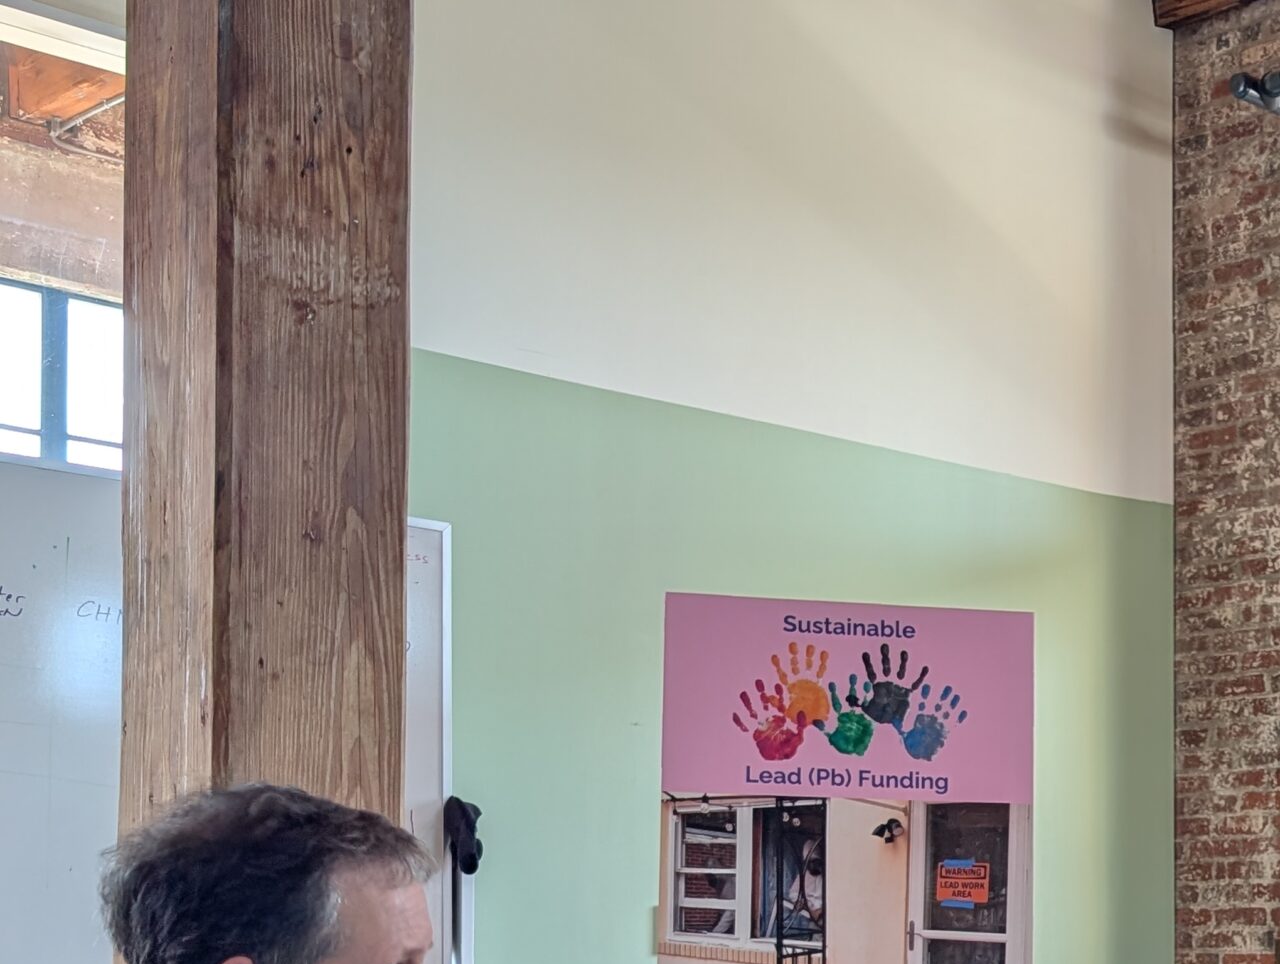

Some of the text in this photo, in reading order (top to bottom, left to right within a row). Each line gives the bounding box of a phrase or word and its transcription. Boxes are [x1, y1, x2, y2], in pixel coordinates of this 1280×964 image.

[783, 615, 916, 639] Sustainable
[745, 766, 949, 795] Lead (Pb) Funding
[944, 866, 982, 877] WARNING
[939, 880, 986, 890] LEAD WORK
[951, 890, 973, 898] AREA
